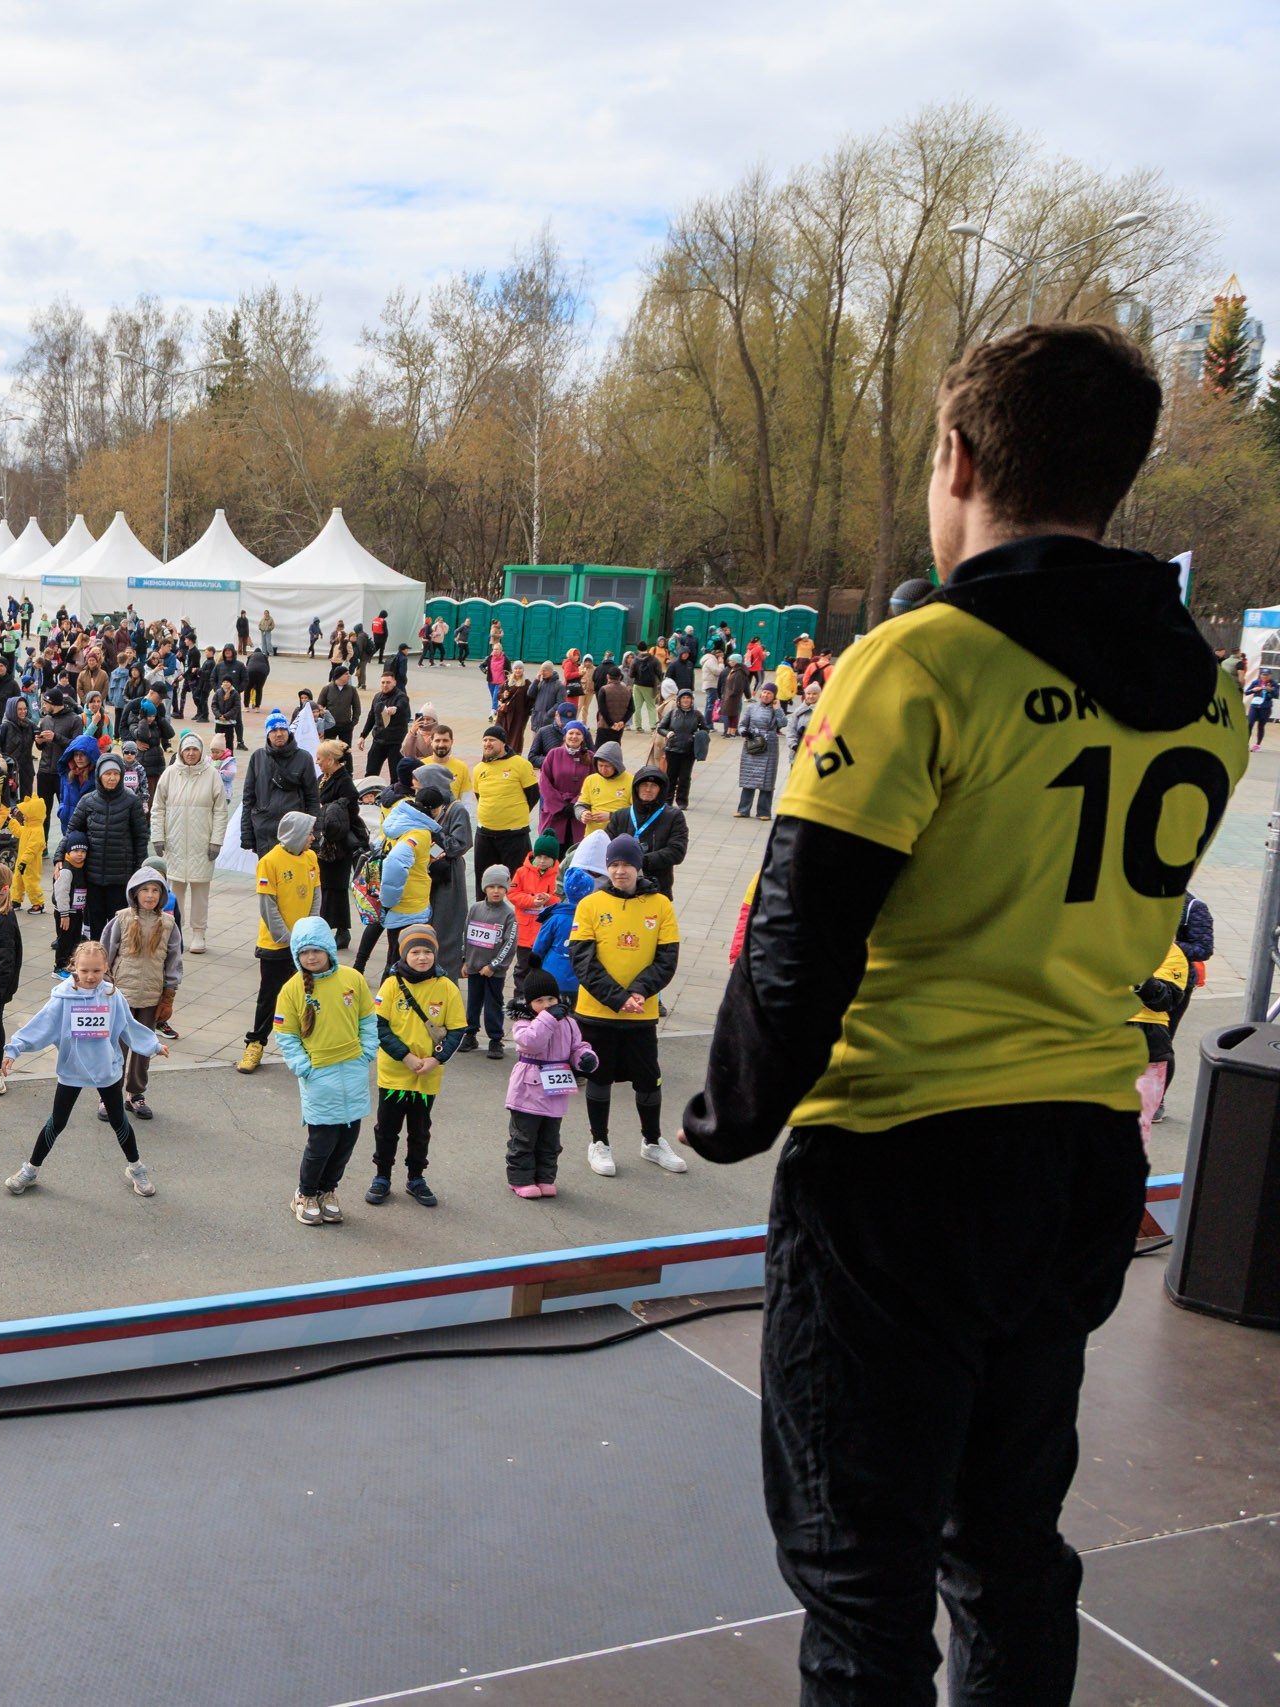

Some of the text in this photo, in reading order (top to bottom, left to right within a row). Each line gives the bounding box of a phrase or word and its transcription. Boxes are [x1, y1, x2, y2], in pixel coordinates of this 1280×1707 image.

[1046, 746, 1231, 903] 10
[470, 929, 491, 940] 5178
[77, 1016, 106, 1027] 5222
[548, 1074, 573, 1085] 5225
